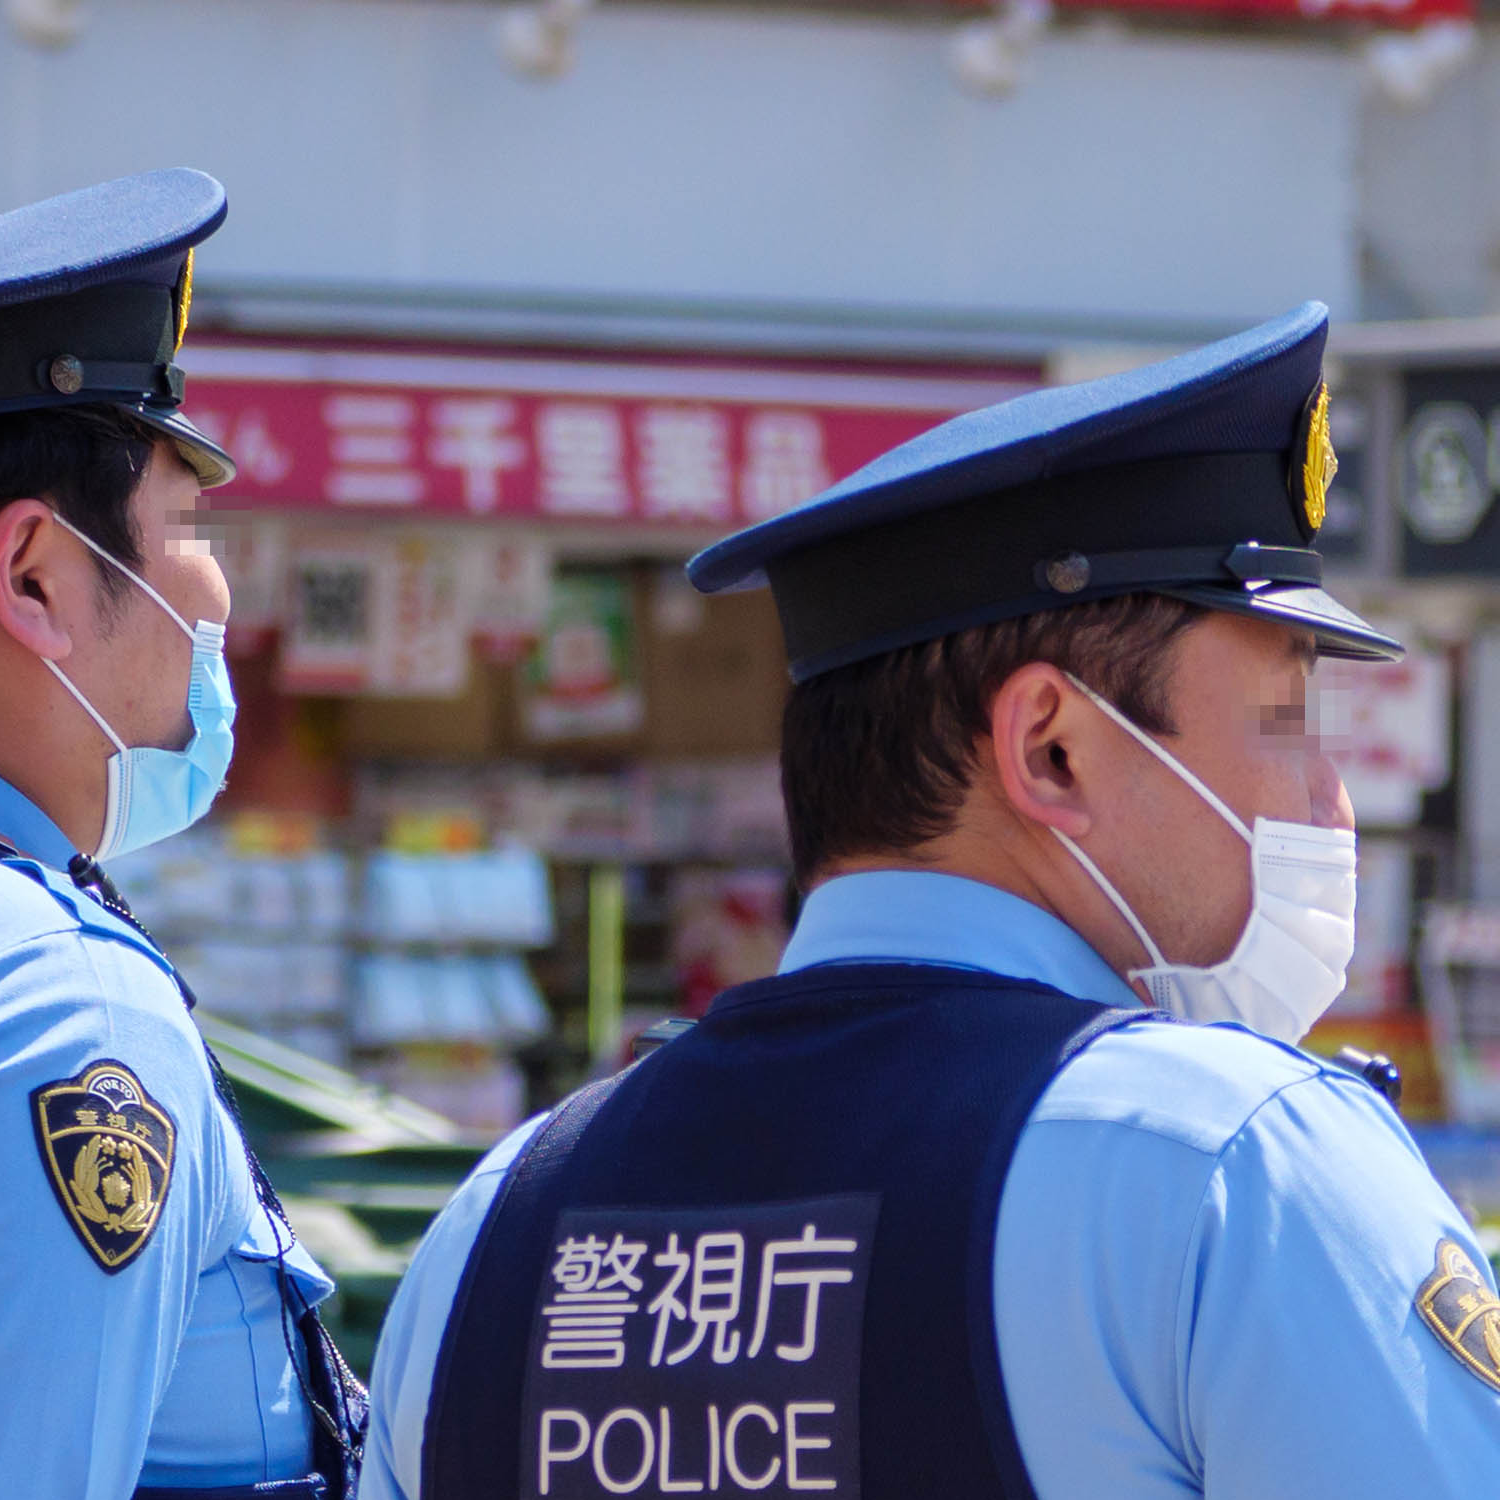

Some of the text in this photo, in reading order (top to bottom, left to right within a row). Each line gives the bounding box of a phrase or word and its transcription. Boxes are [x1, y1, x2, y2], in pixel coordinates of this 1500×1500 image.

[323, 395, 835, 523] 三千里薬品
[75, 1109, 153, 1140] 警視庁
[96, 1078, 134, 1100] TOKYO
[541, 1223, 858, 1369] 警視庁
[538, 1401, 838, 1496] POLICE
